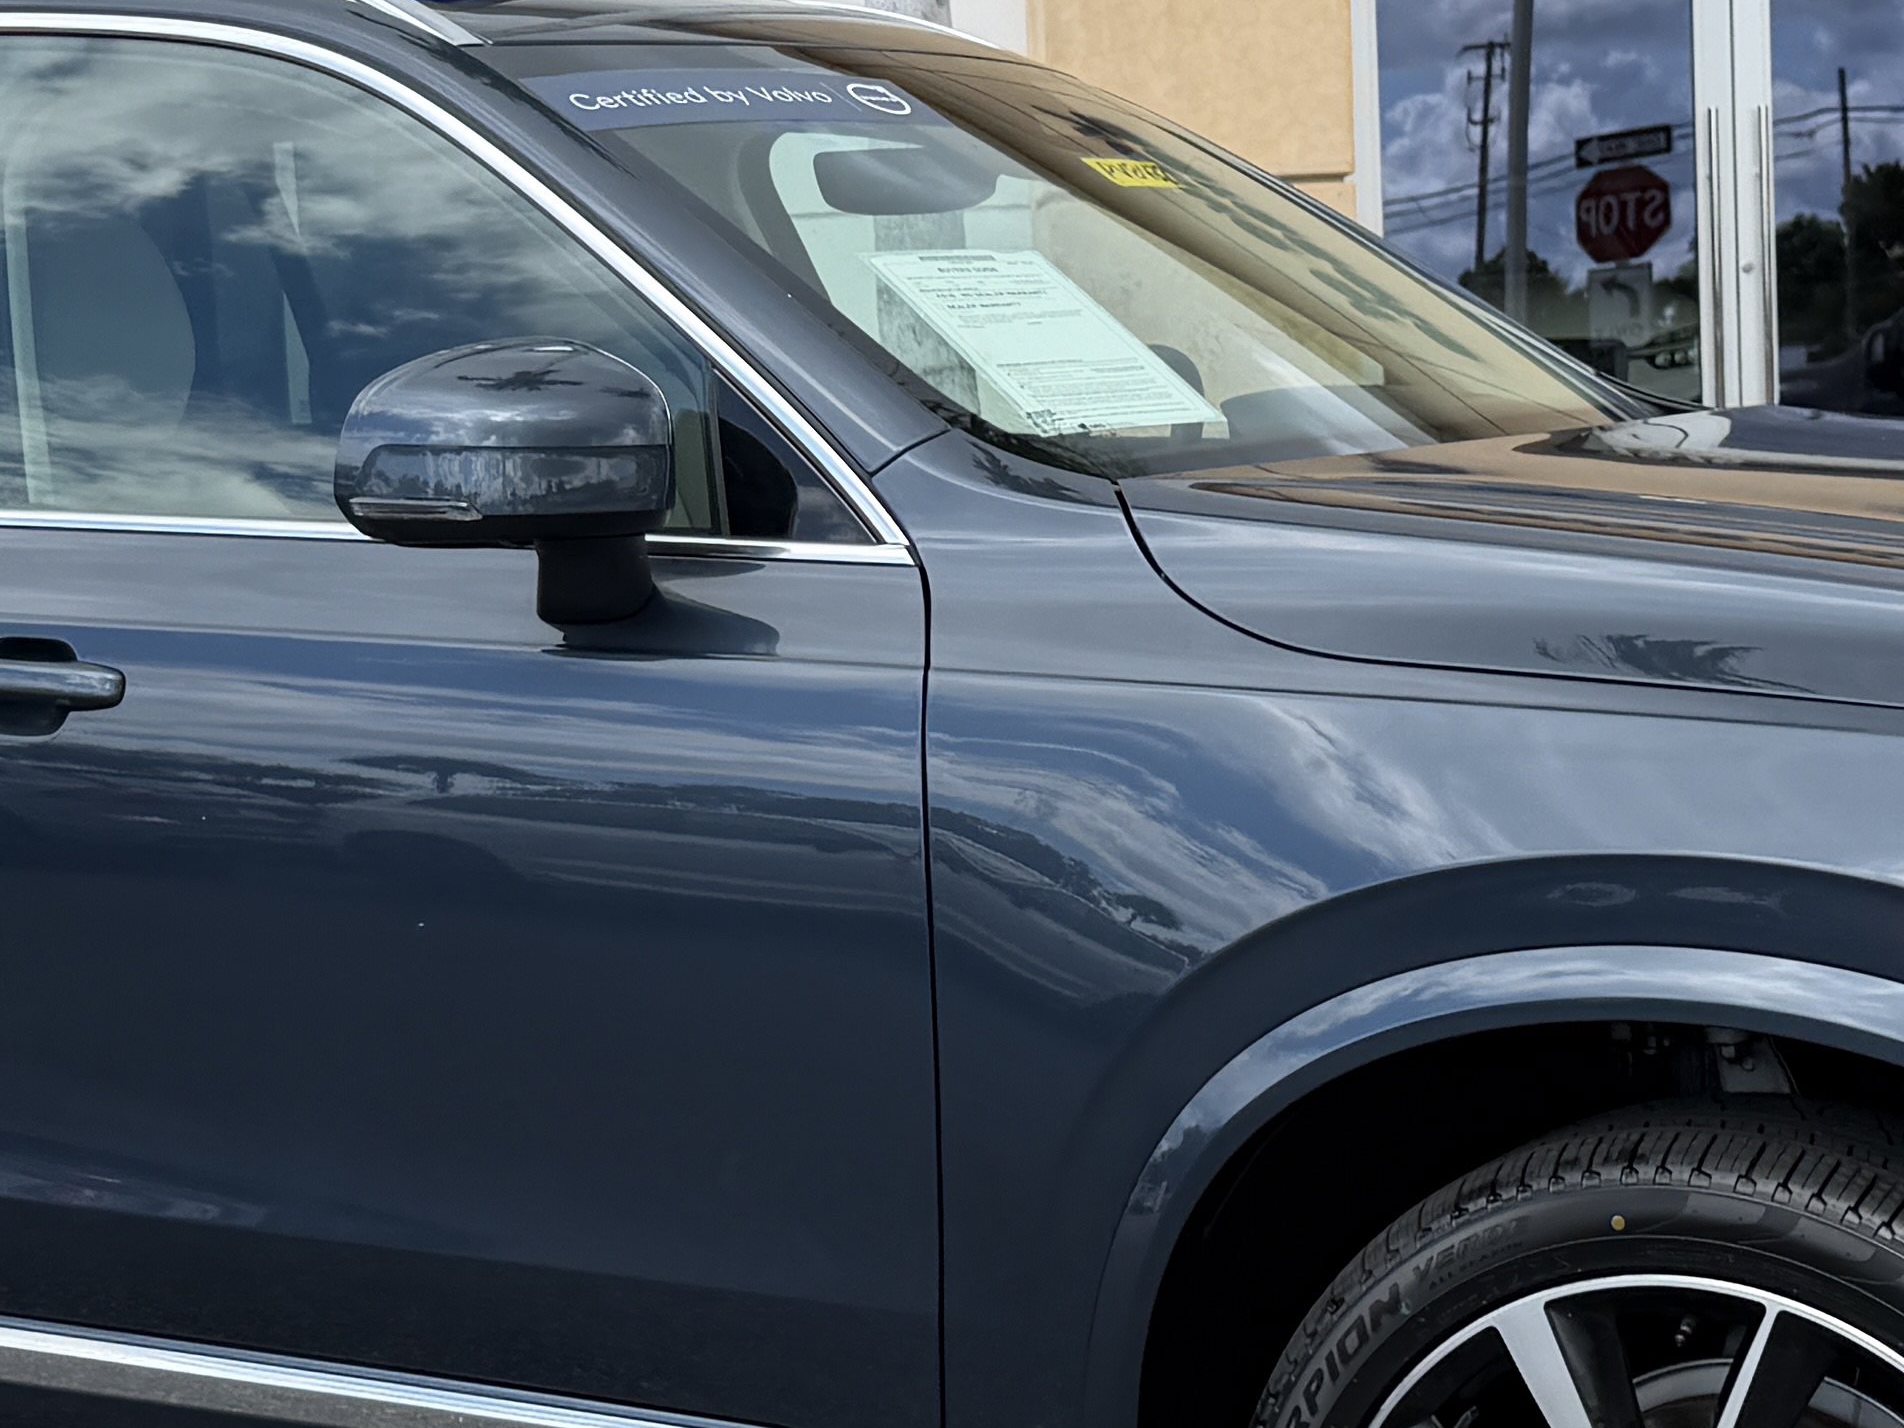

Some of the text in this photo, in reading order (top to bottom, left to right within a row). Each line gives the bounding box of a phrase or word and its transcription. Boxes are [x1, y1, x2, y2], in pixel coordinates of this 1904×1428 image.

[569, 85, 833, 111] Certified by Volvo
